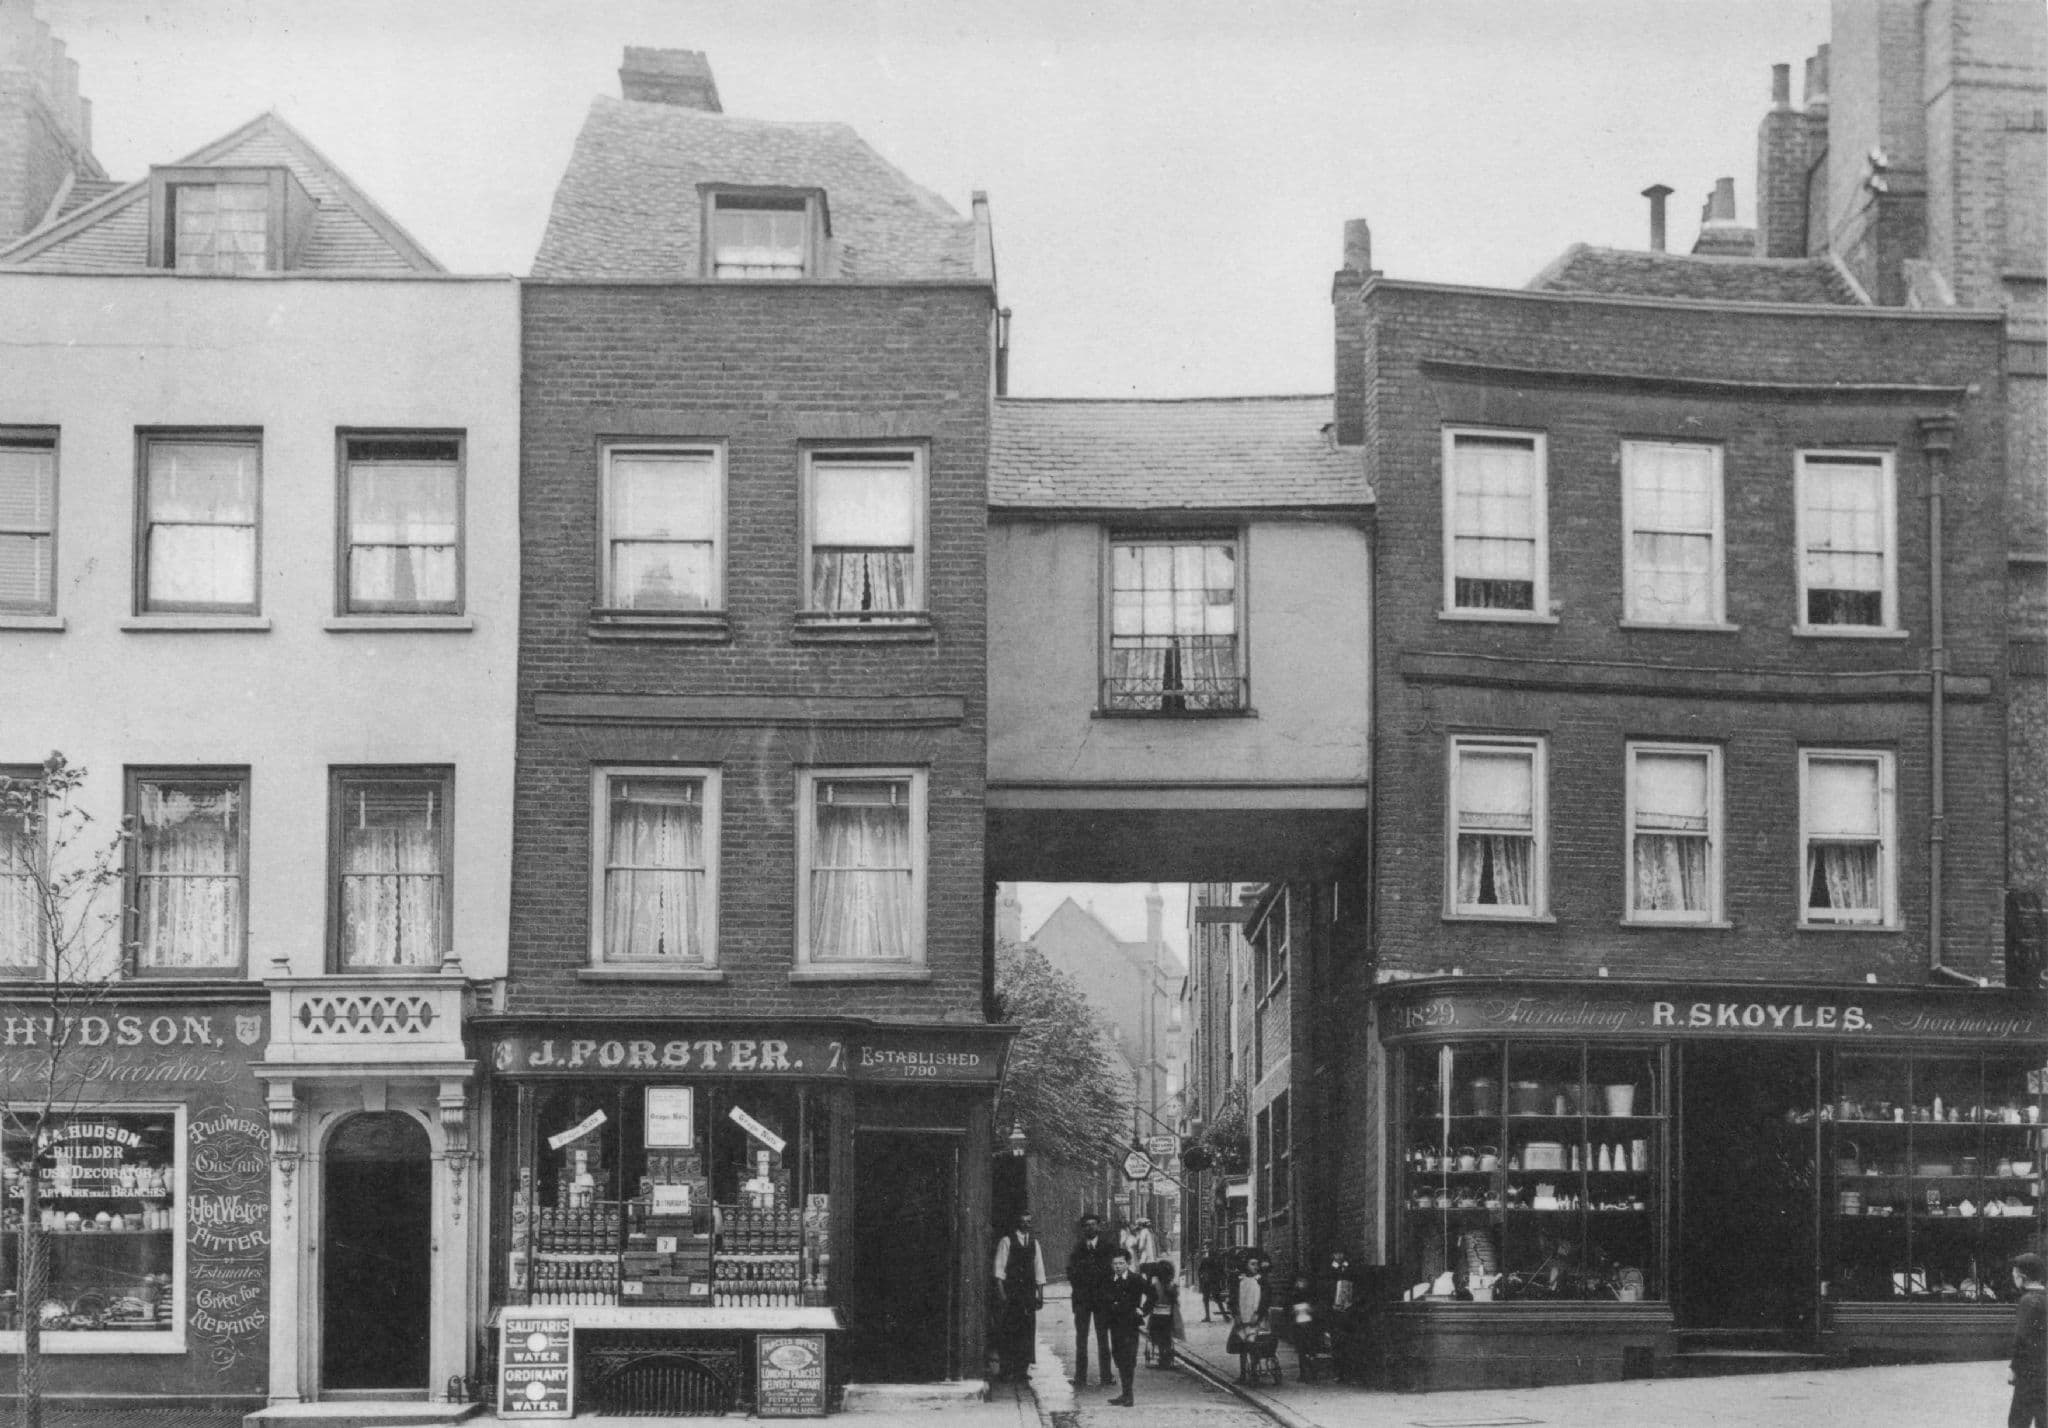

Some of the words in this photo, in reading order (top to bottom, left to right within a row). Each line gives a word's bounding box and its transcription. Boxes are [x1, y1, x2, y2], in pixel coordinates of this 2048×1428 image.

[860, 1046, 980, 1066] ESTABLISHED
[189, 1114, 269, 1150] PLUMBER
[53, 1146, 124, 1159] BUILDER
[187, 1227, 271, 1252] FITTER
[189, 1308, 265, 1334] REPAIRS
[507, 1320, 570, 1334] SALUTARIS
[513, 1352, 560, 1362] WATER
[505, 1369, 568, 1382] ORDINARY
[512, 1401, 559, 1411] WATER
